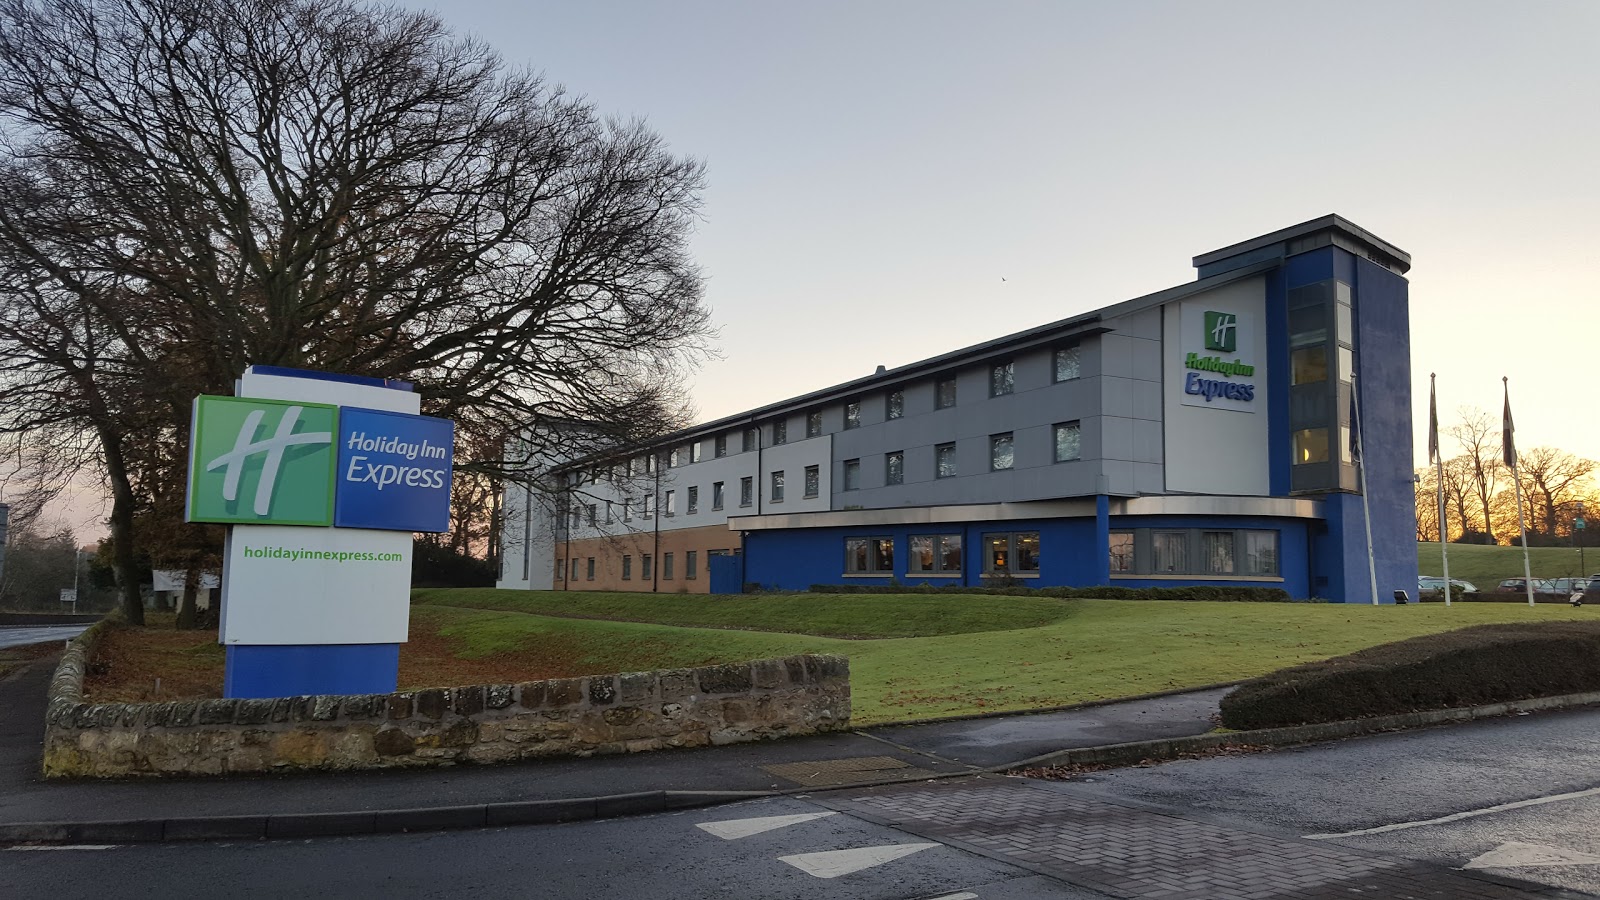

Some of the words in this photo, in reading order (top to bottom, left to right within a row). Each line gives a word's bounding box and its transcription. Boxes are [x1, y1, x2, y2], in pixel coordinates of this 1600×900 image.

[1185, 352, 1234, 377] Holiday
[1233, 359, 1254, 377] Inn
[1184, 372, 1255, 402] Express
[348, 431, 419, 460] Holiday
[420, 439, 446, 460] Inn
[346, 455, 445, 491] Express
[243, 546, 403, 563] holidayinnexpress.com
